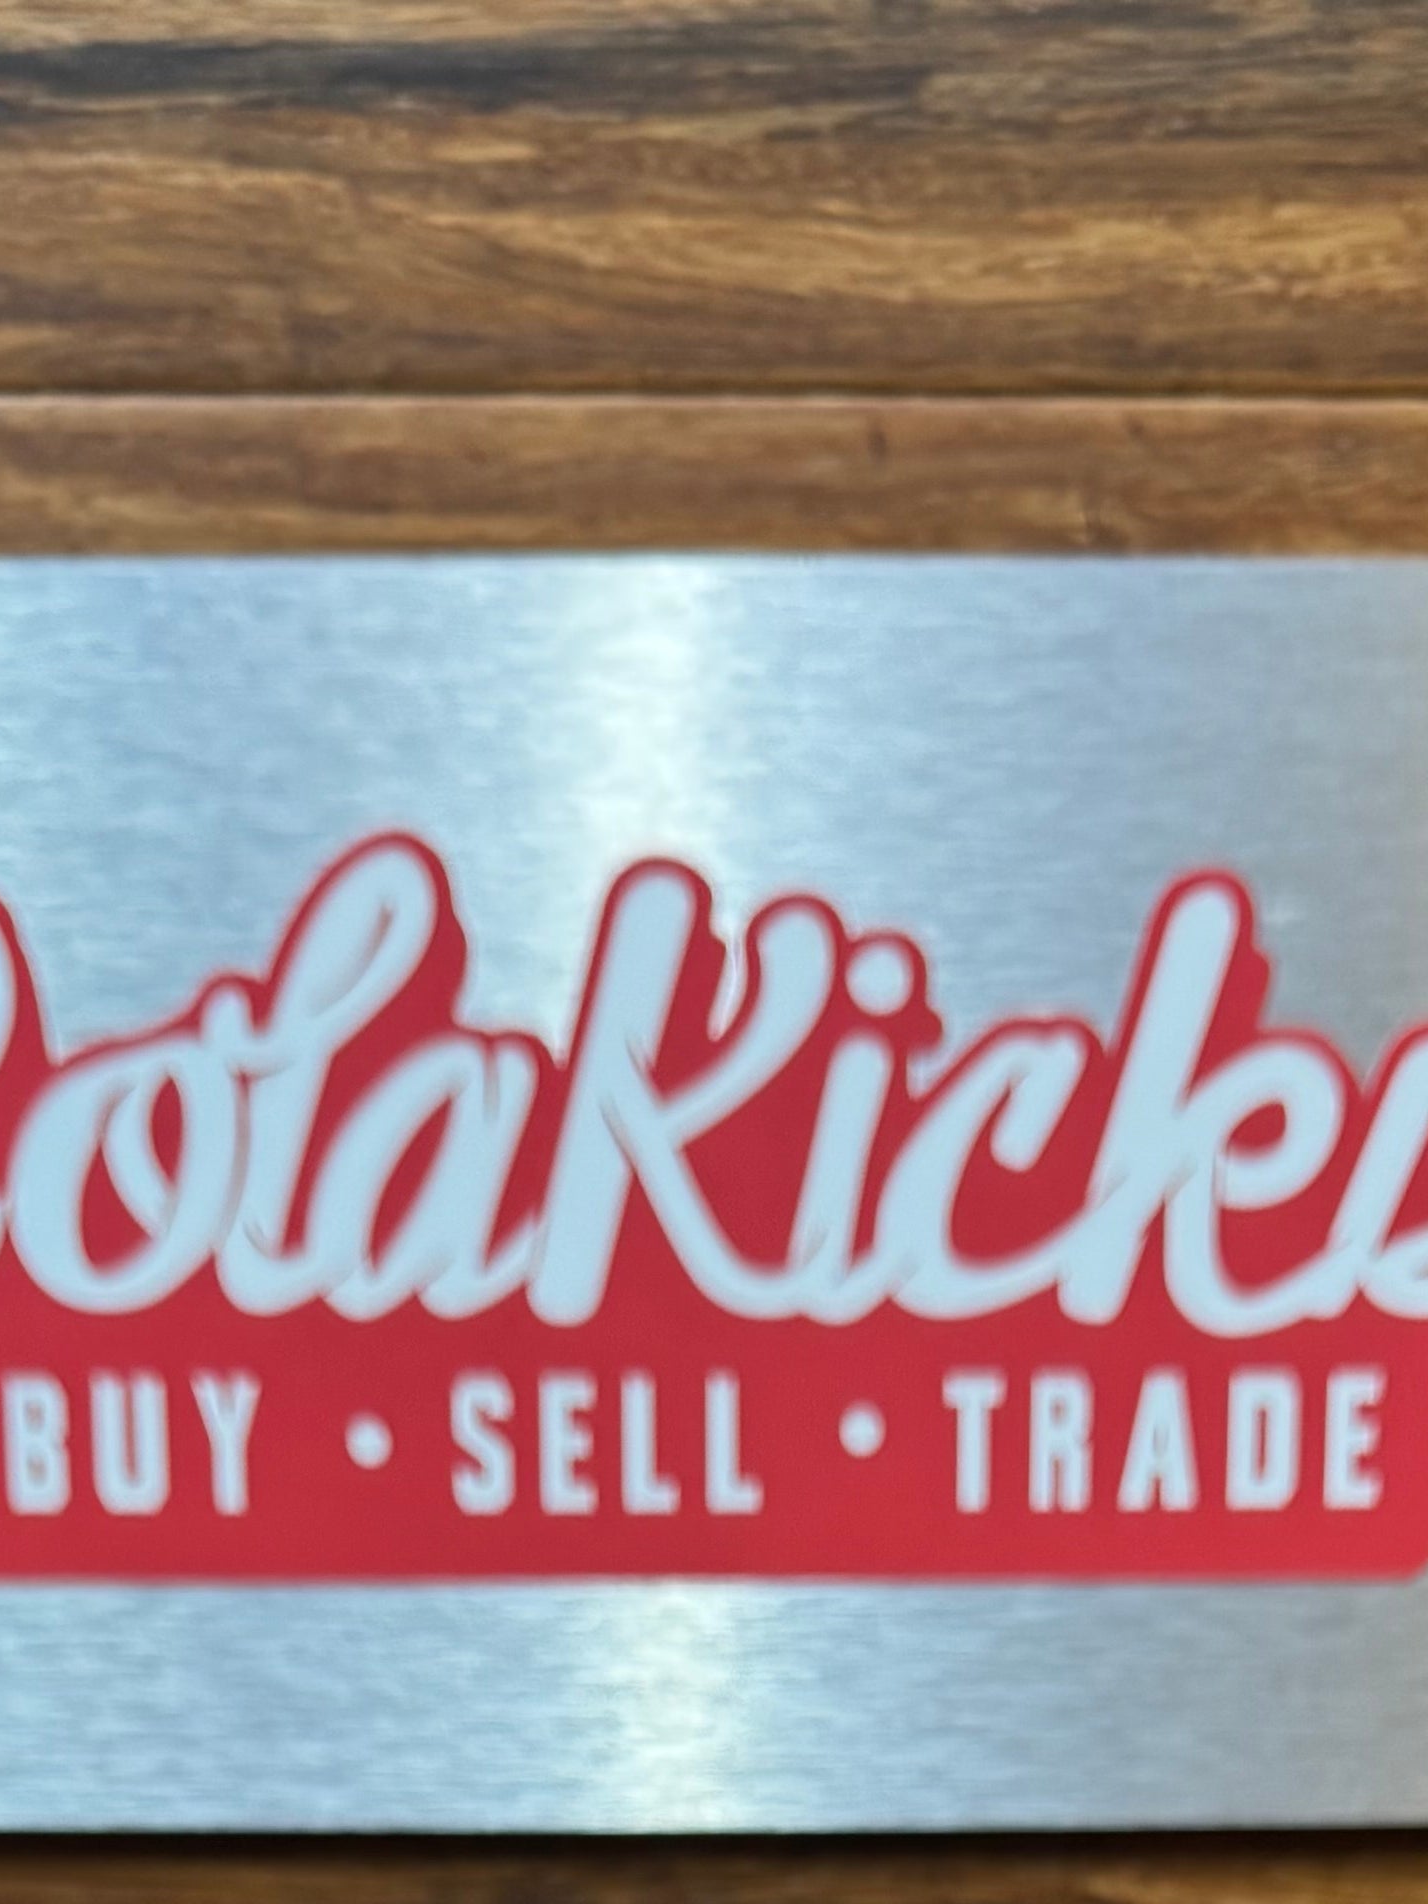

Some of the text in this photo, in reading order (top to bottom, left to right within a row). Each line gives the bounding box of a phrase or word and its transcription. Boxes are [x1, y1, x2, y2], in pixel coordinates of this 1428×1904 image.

[0, 1366, 1386, 1516] BUY SELL TRADE
